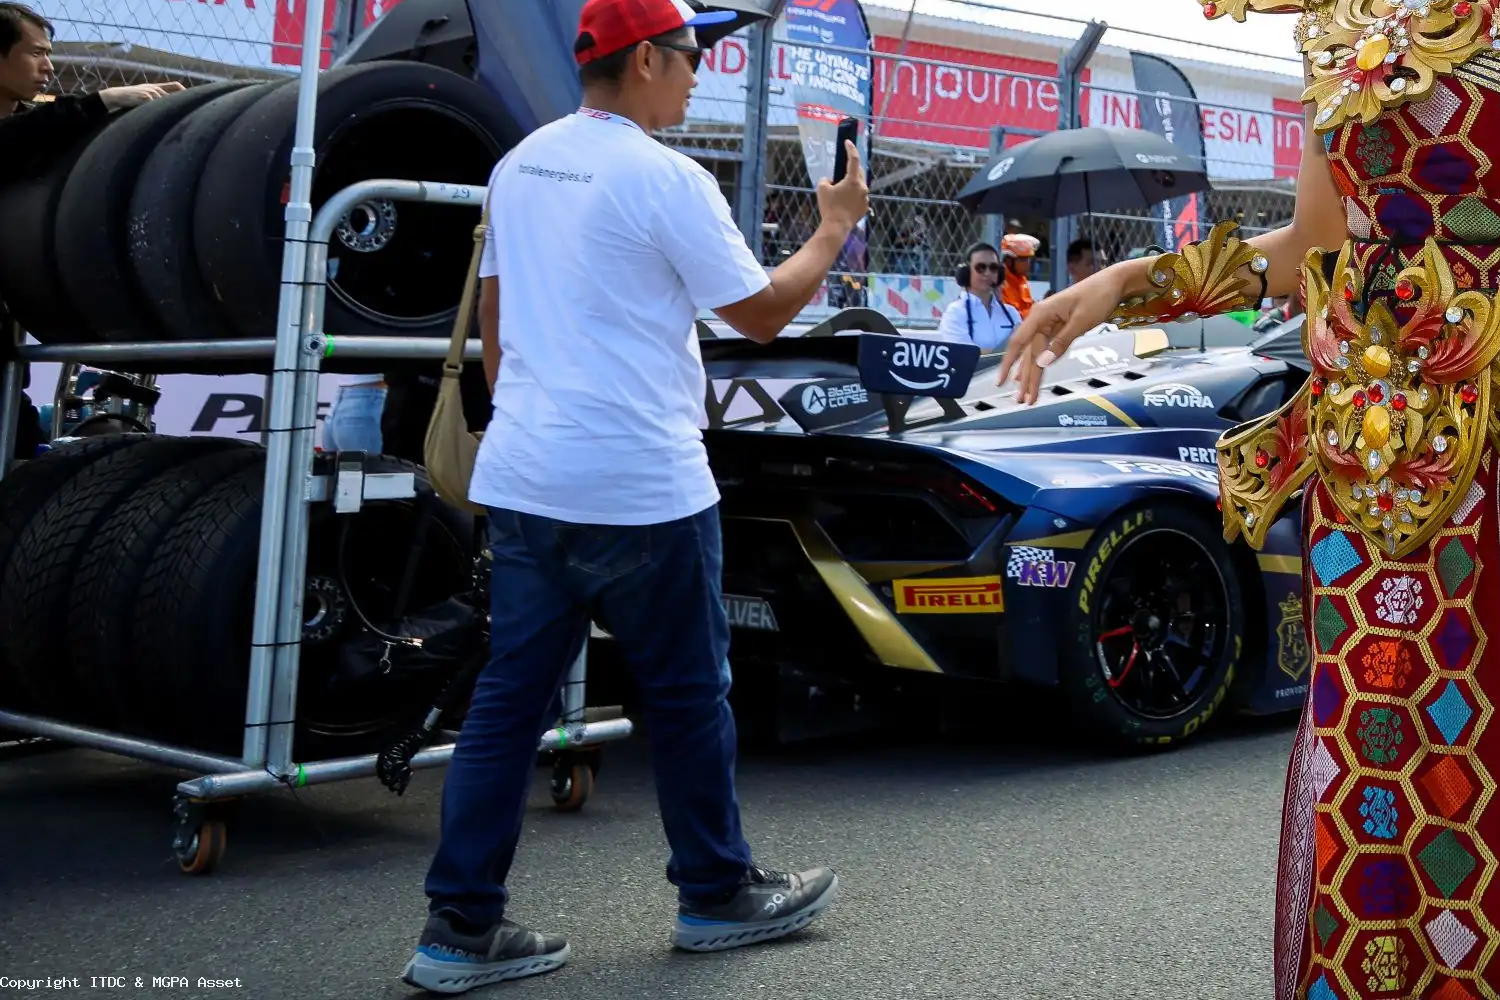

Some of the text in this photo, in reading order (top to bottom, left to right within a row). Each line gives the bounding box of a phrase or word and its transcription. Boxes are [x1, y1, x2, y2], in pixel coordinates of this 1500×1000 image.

[879, 60, 1084, 112] injourne
[519, 165, 593, 183] totalenergies.id
[892, 341, 950, 371] aws
[1018, 560, 1076, 588] KW
[1079, 512, 1143, 614] PIRELLI
[903, 583, 1001, 607] PIRELLI
